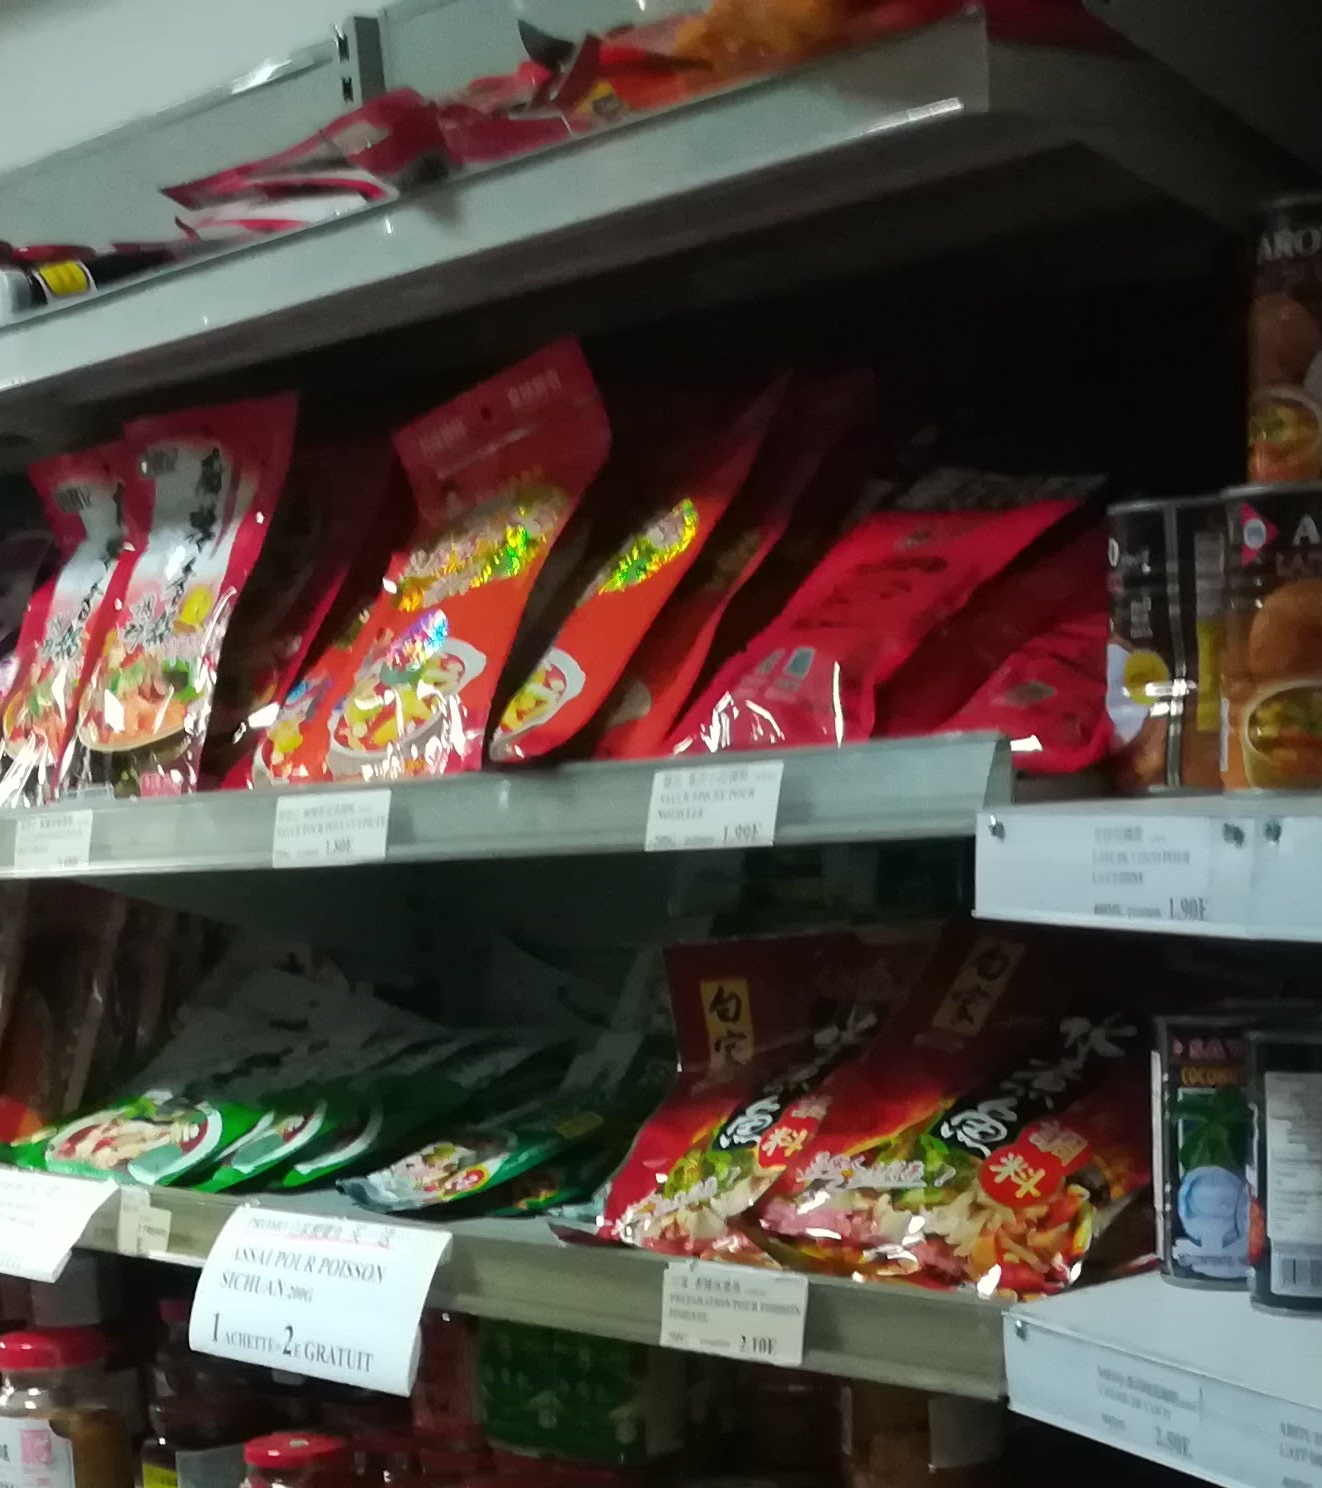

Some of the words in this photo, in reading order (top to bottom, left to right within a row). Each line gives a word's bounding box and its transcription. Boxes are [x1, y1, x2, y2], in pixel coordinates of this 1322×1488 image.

[219, 1271, 285, 1297] SICHUAN
[317, 1257, 387, 1285] POISSON
[304, 1341, 375, 1373] GRATUIT
